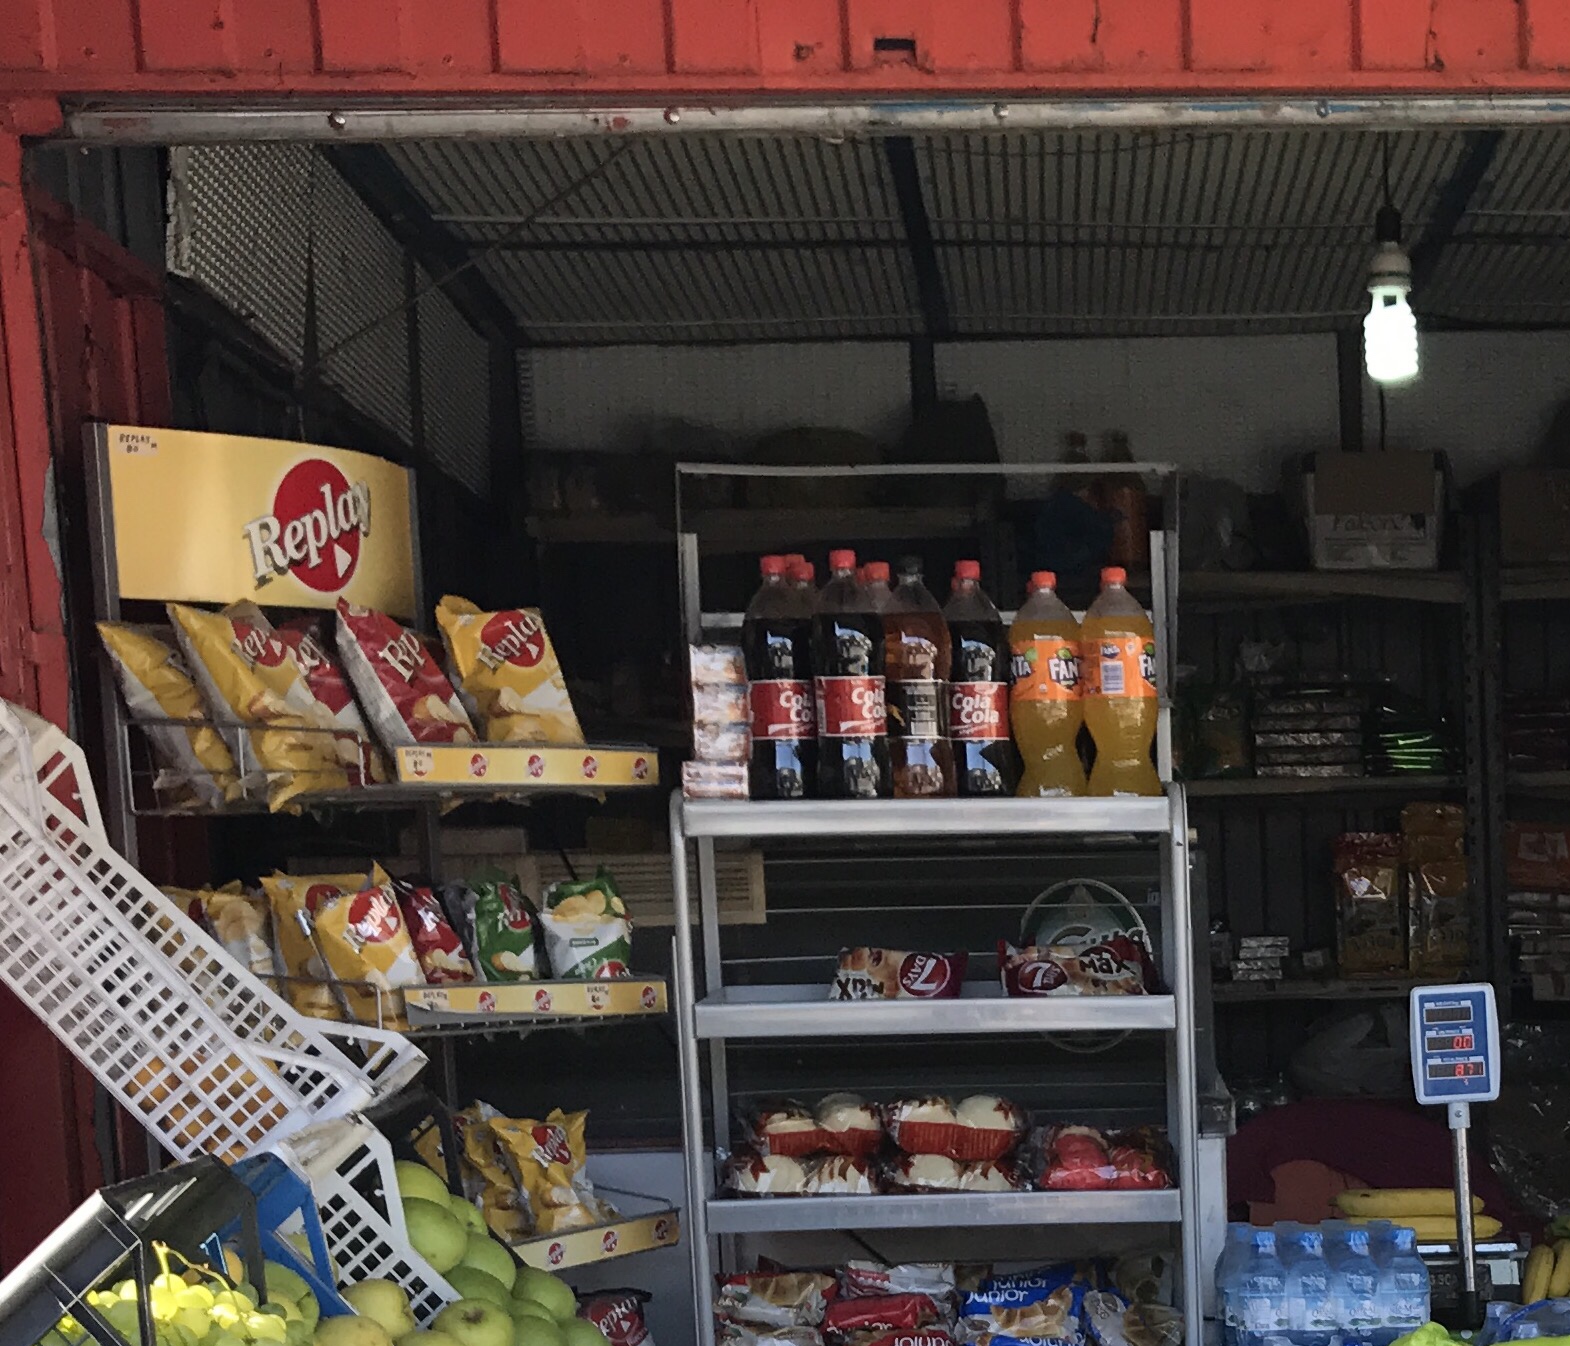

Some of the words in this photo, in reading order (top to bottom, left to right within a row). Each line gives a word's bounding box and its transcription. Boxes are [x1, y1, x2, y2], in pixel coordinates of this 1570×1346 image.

[243, 480, 371, 582] Replay
[952, 692, 992, 710] Cola
[960, 707, 1000, 724] Cola
[902, 954, 927, 987] DAYS
[910, 957, 937, 990] 7
[1024, 962, 1050, 988] 7
[966, 1288, 1029, 1305] Junior
